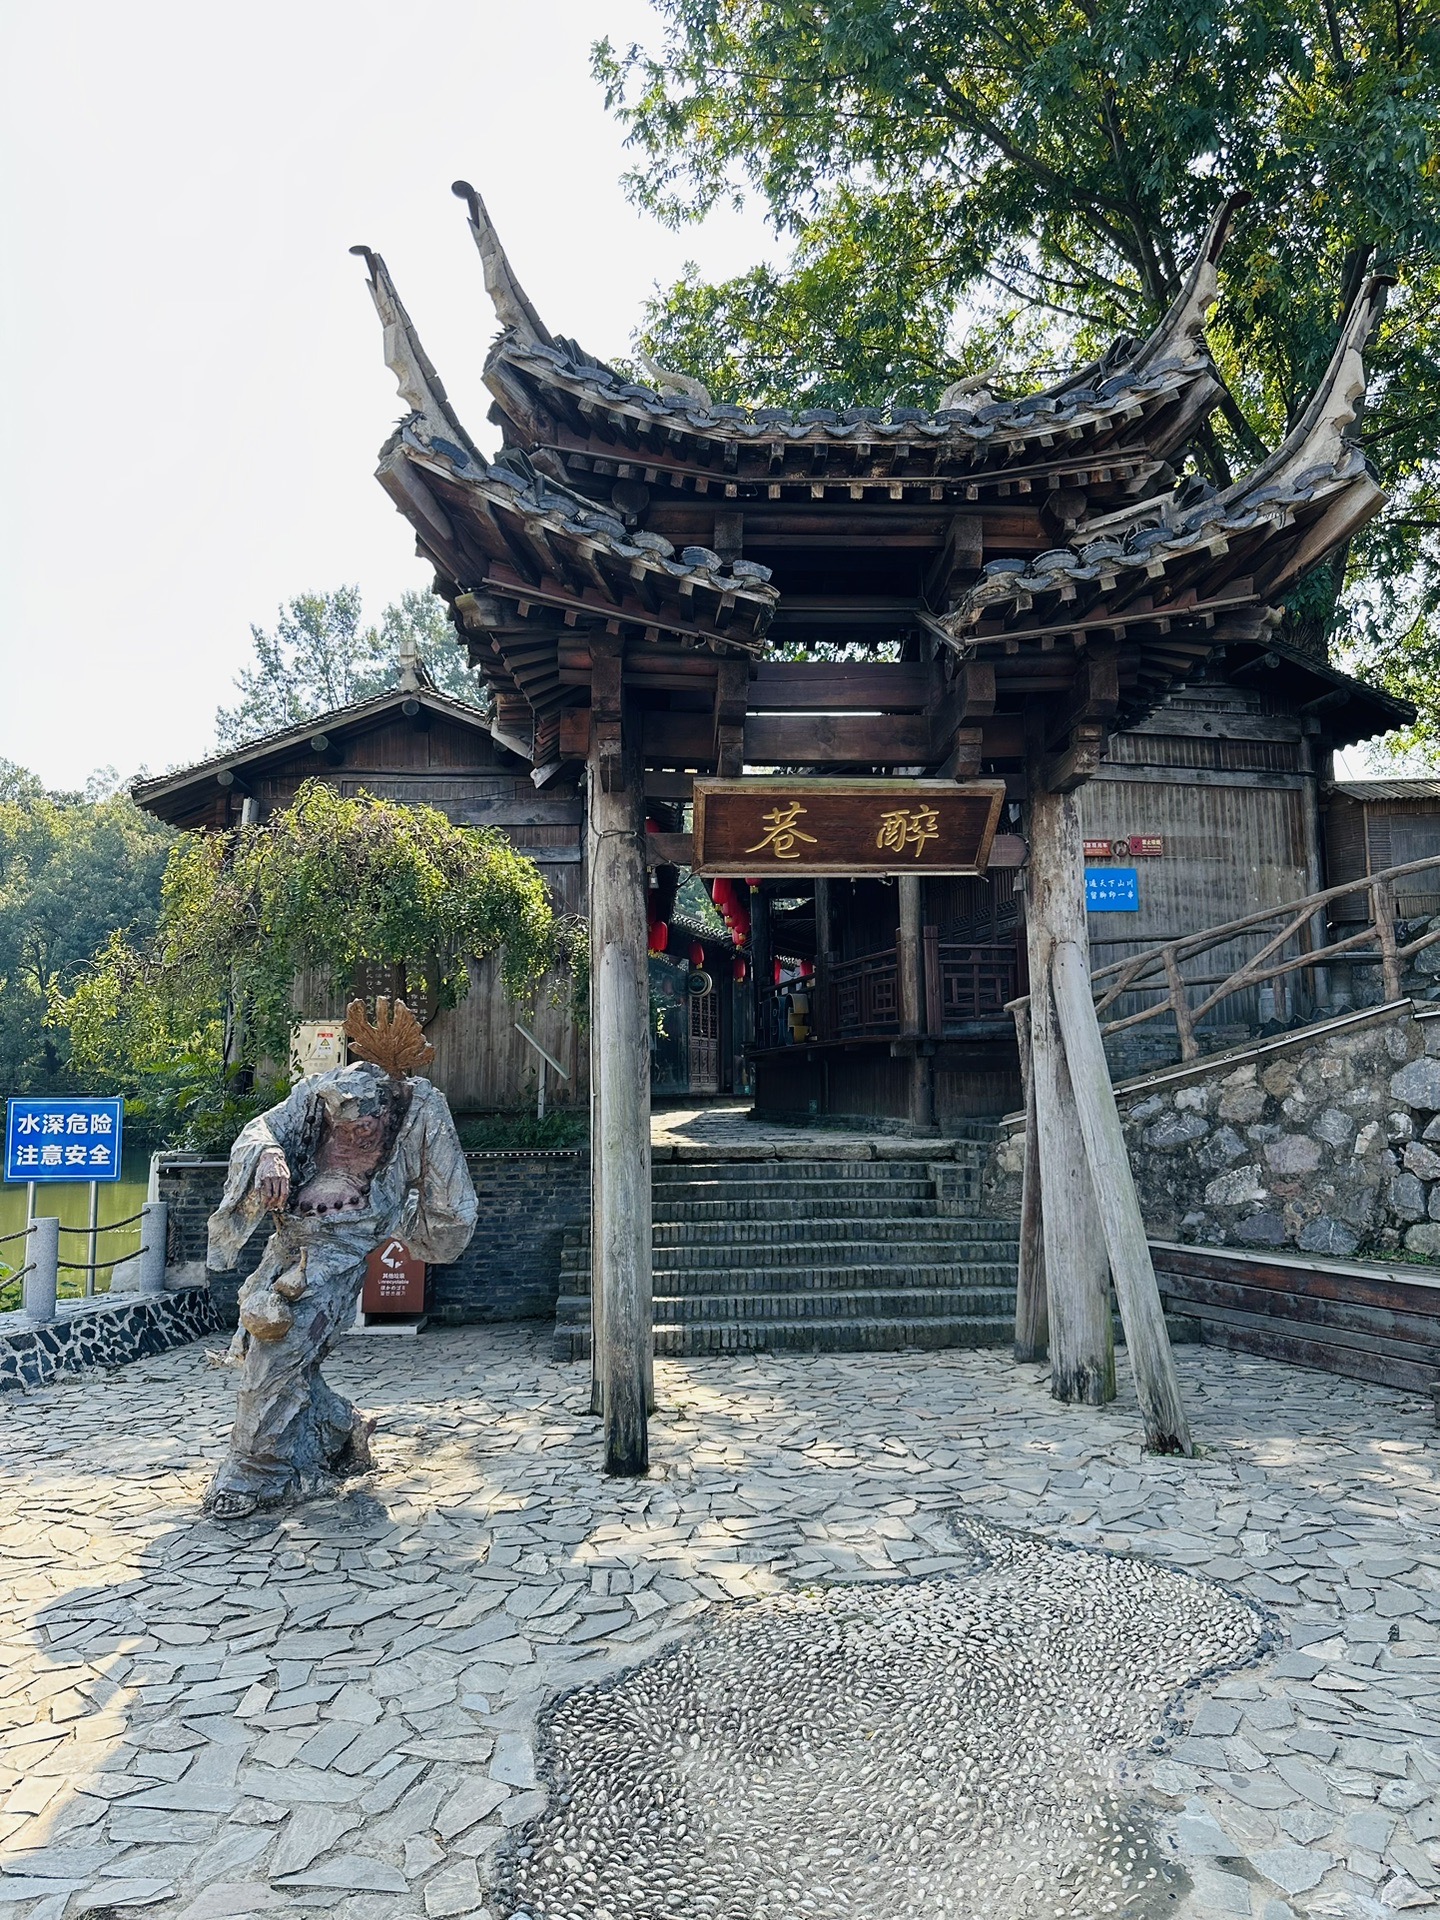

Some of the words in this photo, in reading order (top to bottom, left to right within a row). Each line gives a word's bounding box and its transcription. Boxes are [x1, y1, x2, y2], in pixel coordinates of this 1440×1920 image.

[1085, 890, 1134, 900] 留脚印一串
[17, 1113, 113, 1135] 水深危险
[16, 1144, 112, 1166] 注意安全
